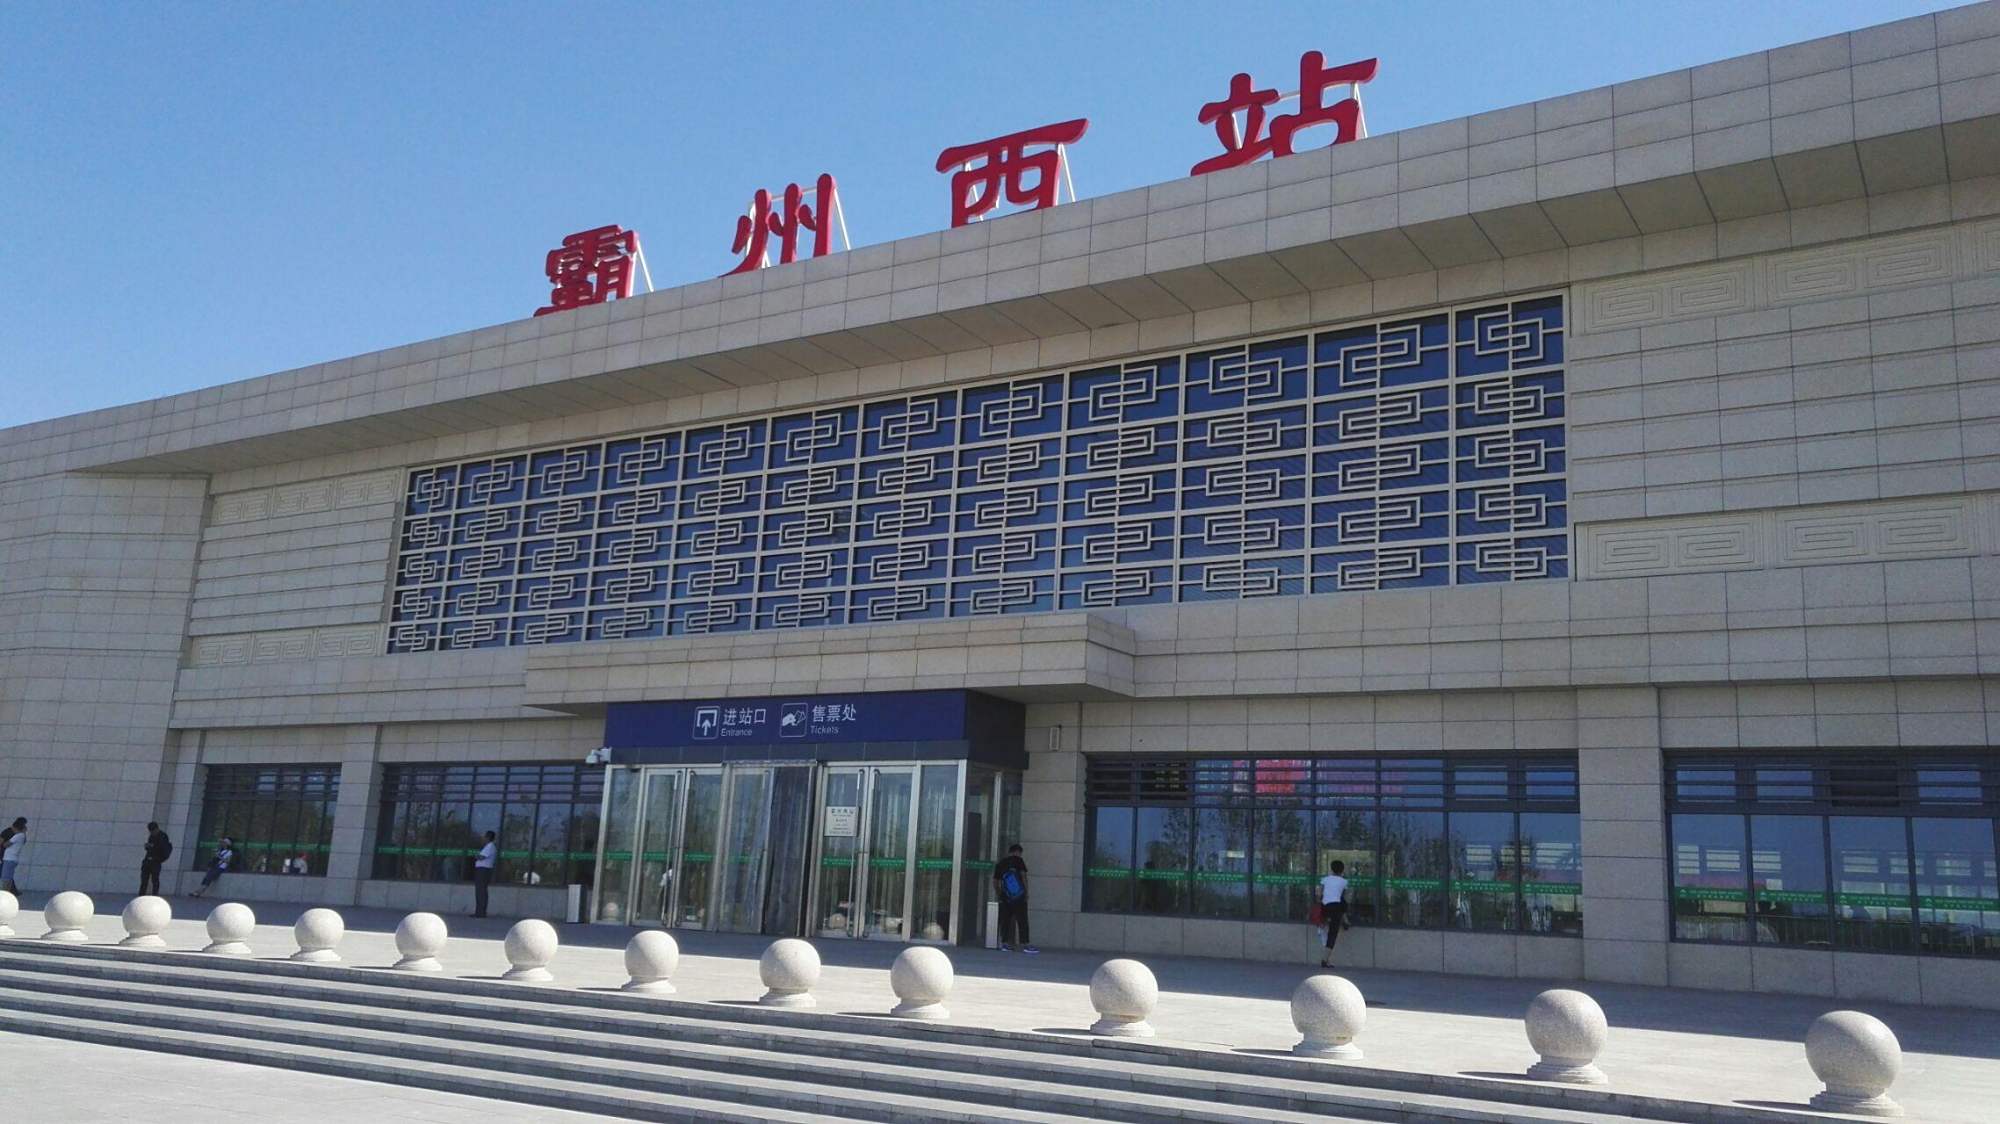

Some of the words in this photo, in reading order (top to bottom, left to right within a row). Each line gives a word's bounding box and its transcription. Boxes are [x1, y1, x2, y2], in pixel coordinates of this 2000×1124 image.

[534, 51, 1377, 316] 霸州西站
[723, 708, 766, 725] 进站口
[812, 704, 856, 722] 售票处
[720, 728, 753, 737] Entrance
[810, 725, 839, 735] Tickets
